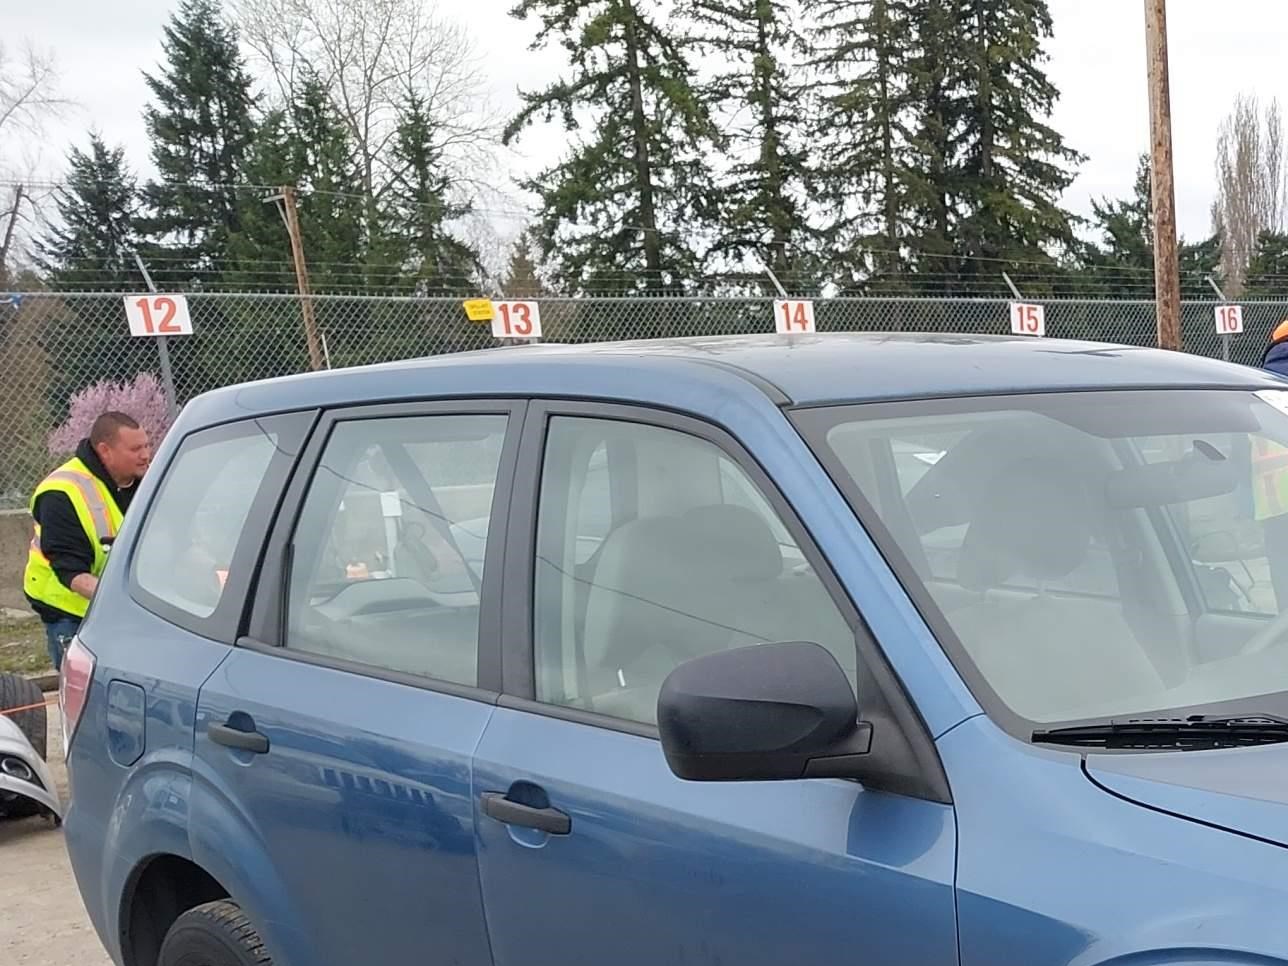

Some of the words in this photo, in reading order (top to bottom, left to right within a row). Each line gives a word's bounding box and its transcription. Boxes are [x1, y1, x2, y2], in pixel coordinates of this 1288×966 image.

[136, 297, 181, 333] 12
[498, 303, 533, 335] 13
[781, 303, 808, 330] 14
[1017, 305, 1038, 332] 15
[1220, 307, 1238, 331] 16
